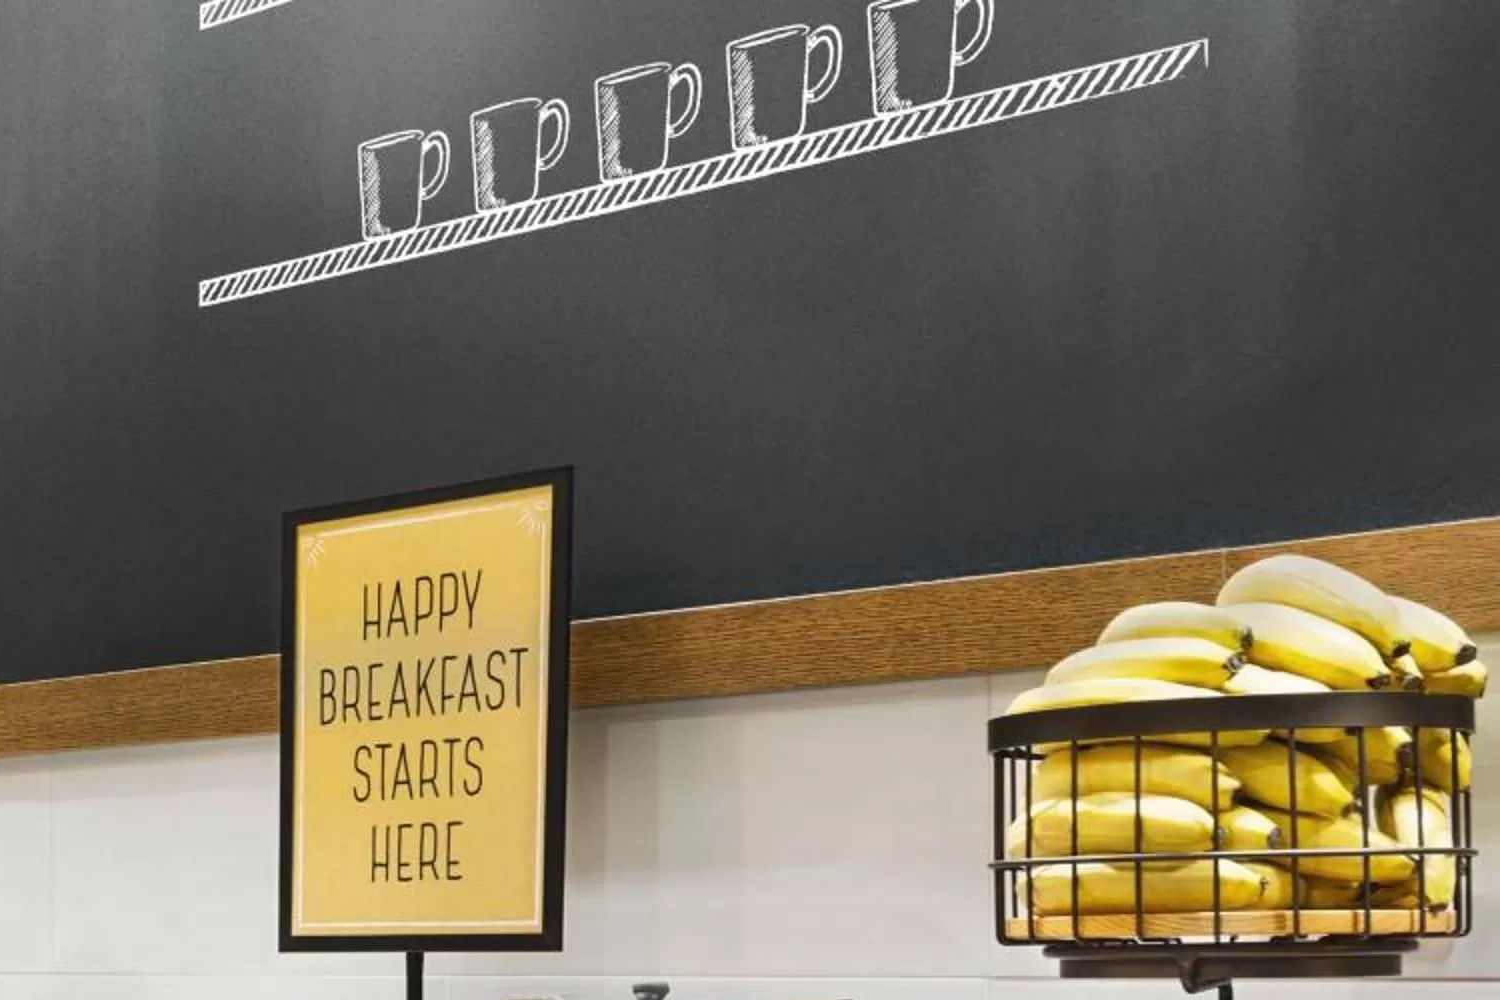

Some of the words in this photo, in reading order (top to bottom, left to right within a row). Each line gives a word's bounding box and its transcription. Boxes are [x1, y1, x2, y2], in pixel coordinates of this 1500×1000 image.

[362, 569, 483, 641] HAPPY
[319, 647, 529, 726] BREAKFAST
[353, 736, 485, 803] STARTS
[371, 821, 463, 882] HERE
